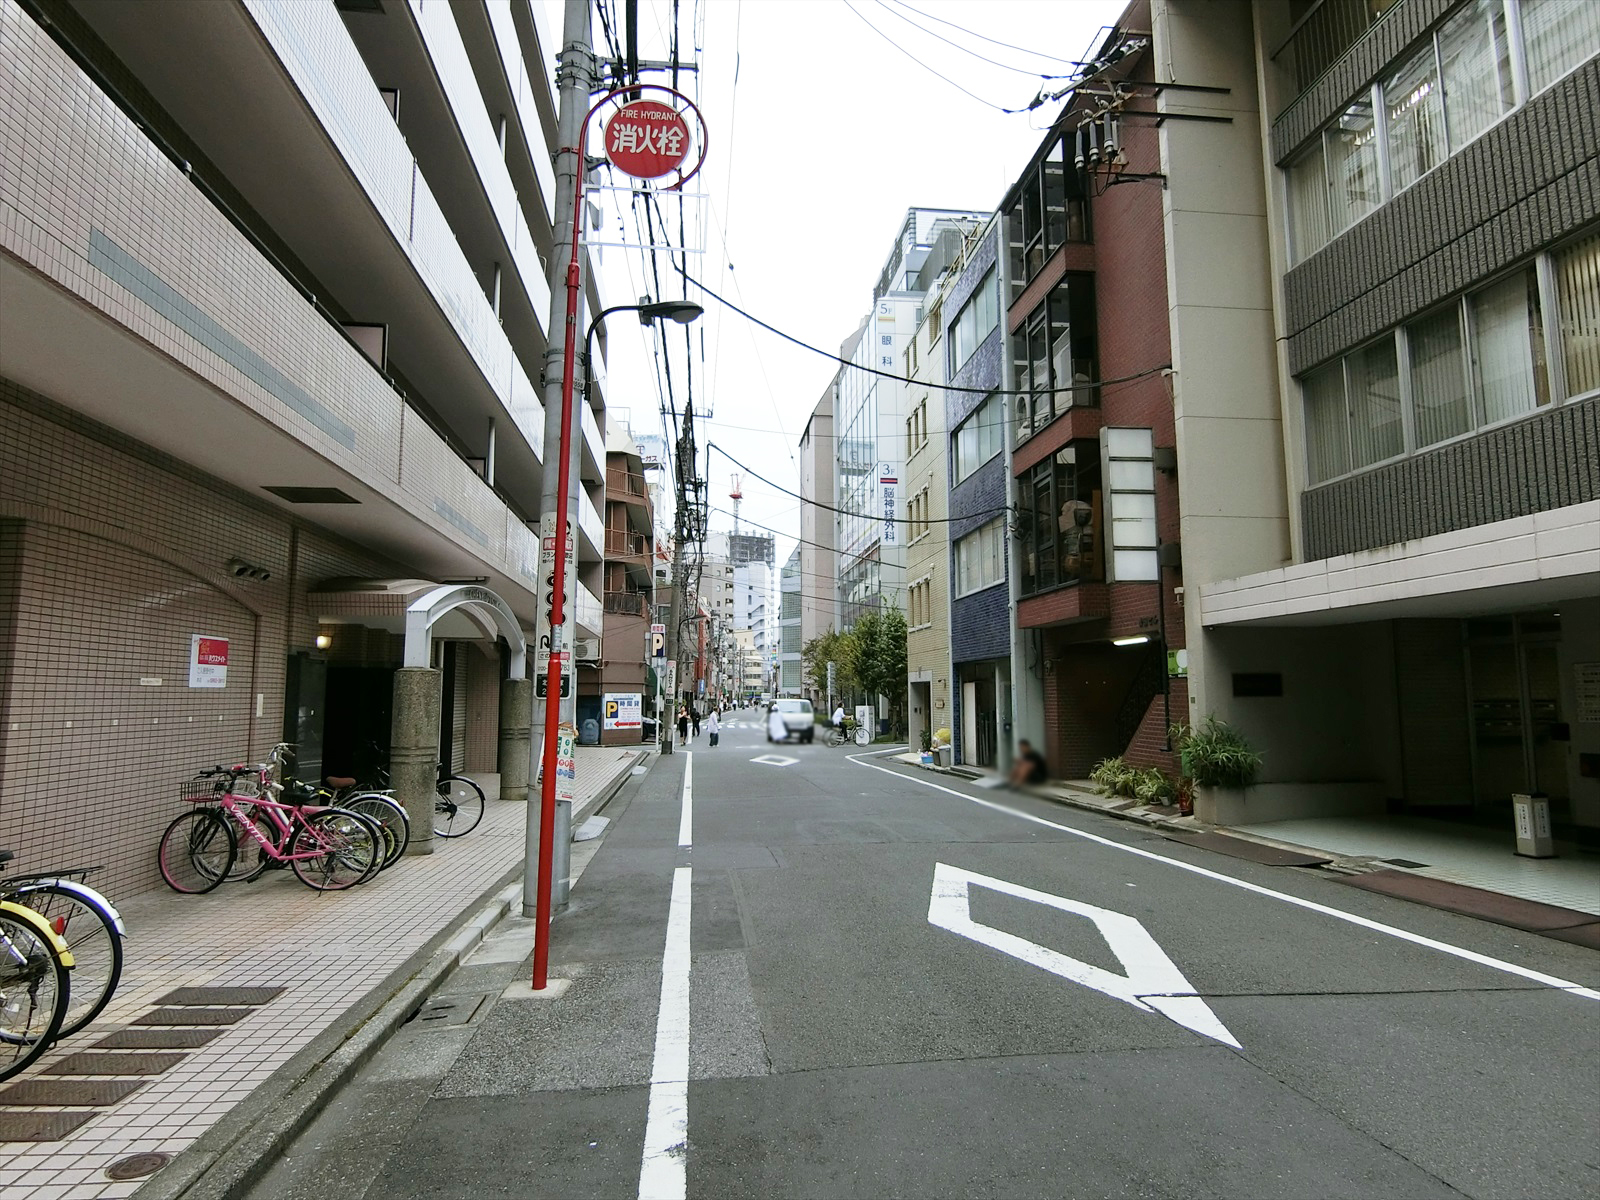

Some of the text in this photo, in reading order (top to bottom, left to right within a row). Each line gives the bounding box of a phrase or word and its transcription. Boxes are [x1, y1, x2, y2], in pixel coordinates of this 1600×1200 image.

[620, 109, 677, 121] FIRE HYDRANT
[611, 122, 684, 156] 消火栓
[880, 303, 893, 315] 5F
[882, 335, 892, 367] 眼科
[882, 464, 895, 476] 3F
[884, 487, 895, 542] 脳神経外科
[652, 634, 664, 656] P
[606, 702, 618, 718] P
[231, 804, 266, 843] VIENTO
